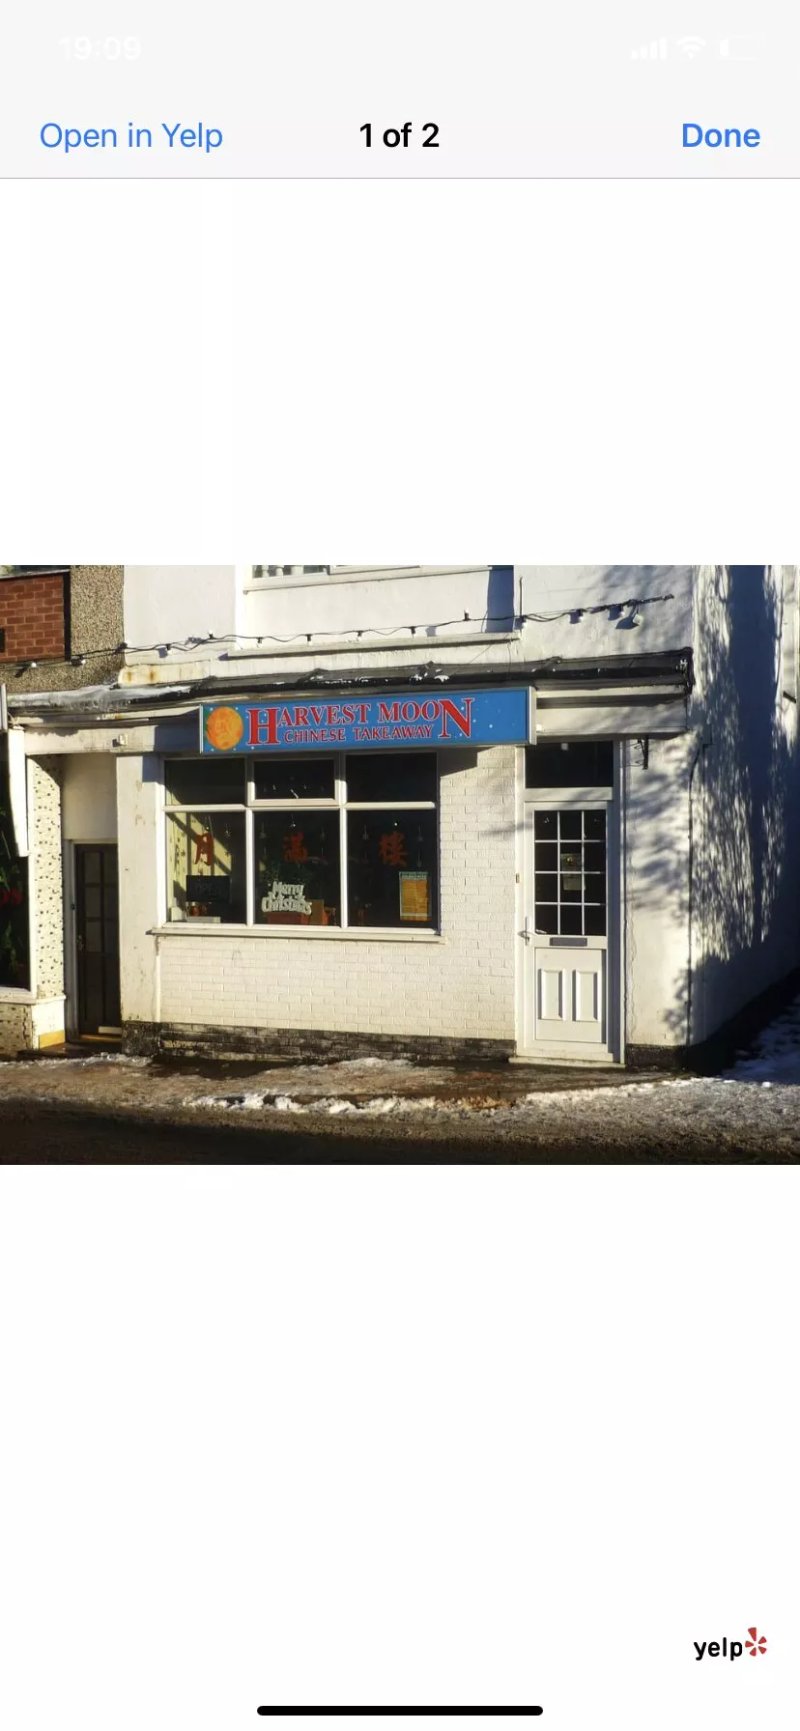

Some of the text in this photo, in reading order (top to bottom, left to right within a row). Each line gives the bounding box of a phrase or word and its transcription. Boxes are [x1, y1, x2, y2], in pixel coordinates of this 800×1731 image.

[246, 697, 475, 746] HARVEST MOON
[284, 724, 434, 743] CHINESE TAKEAWAY
[272, 880, 304, 898] Merry
